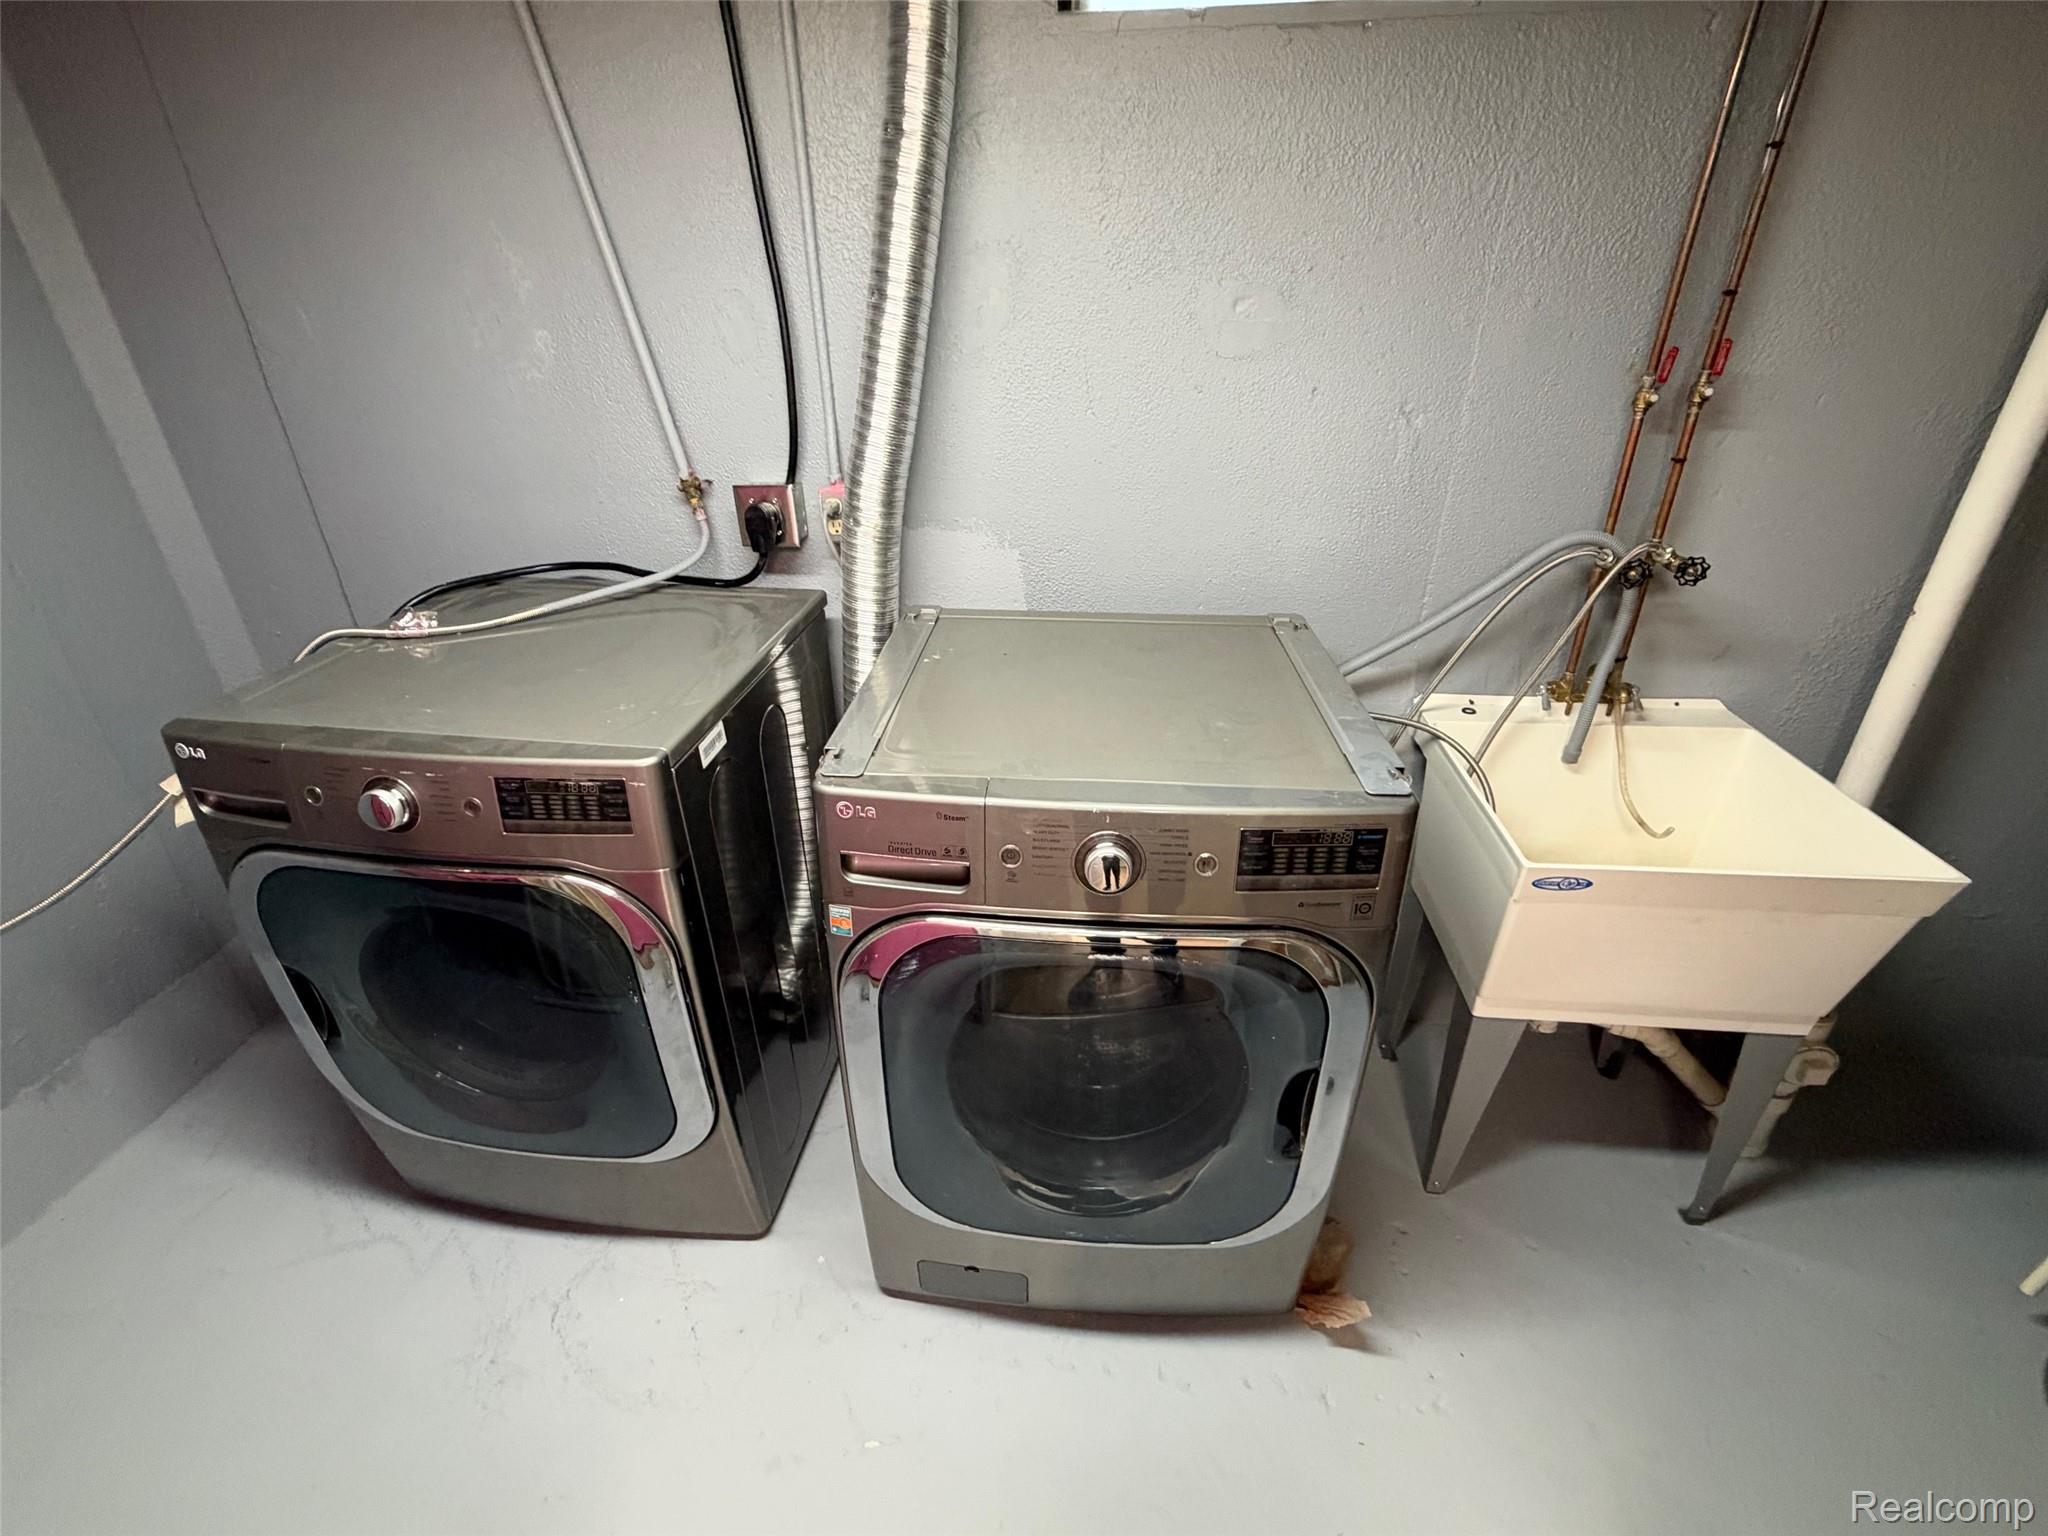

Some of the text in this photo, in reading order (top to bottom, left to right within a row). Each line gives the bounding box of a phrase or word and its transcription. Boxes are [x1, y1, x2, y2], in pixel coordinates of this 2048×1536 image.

[943, 814, 966, 822] Steam
[888, 845, 913, 855] Direct
[914, 847, 937, 857] Drive
